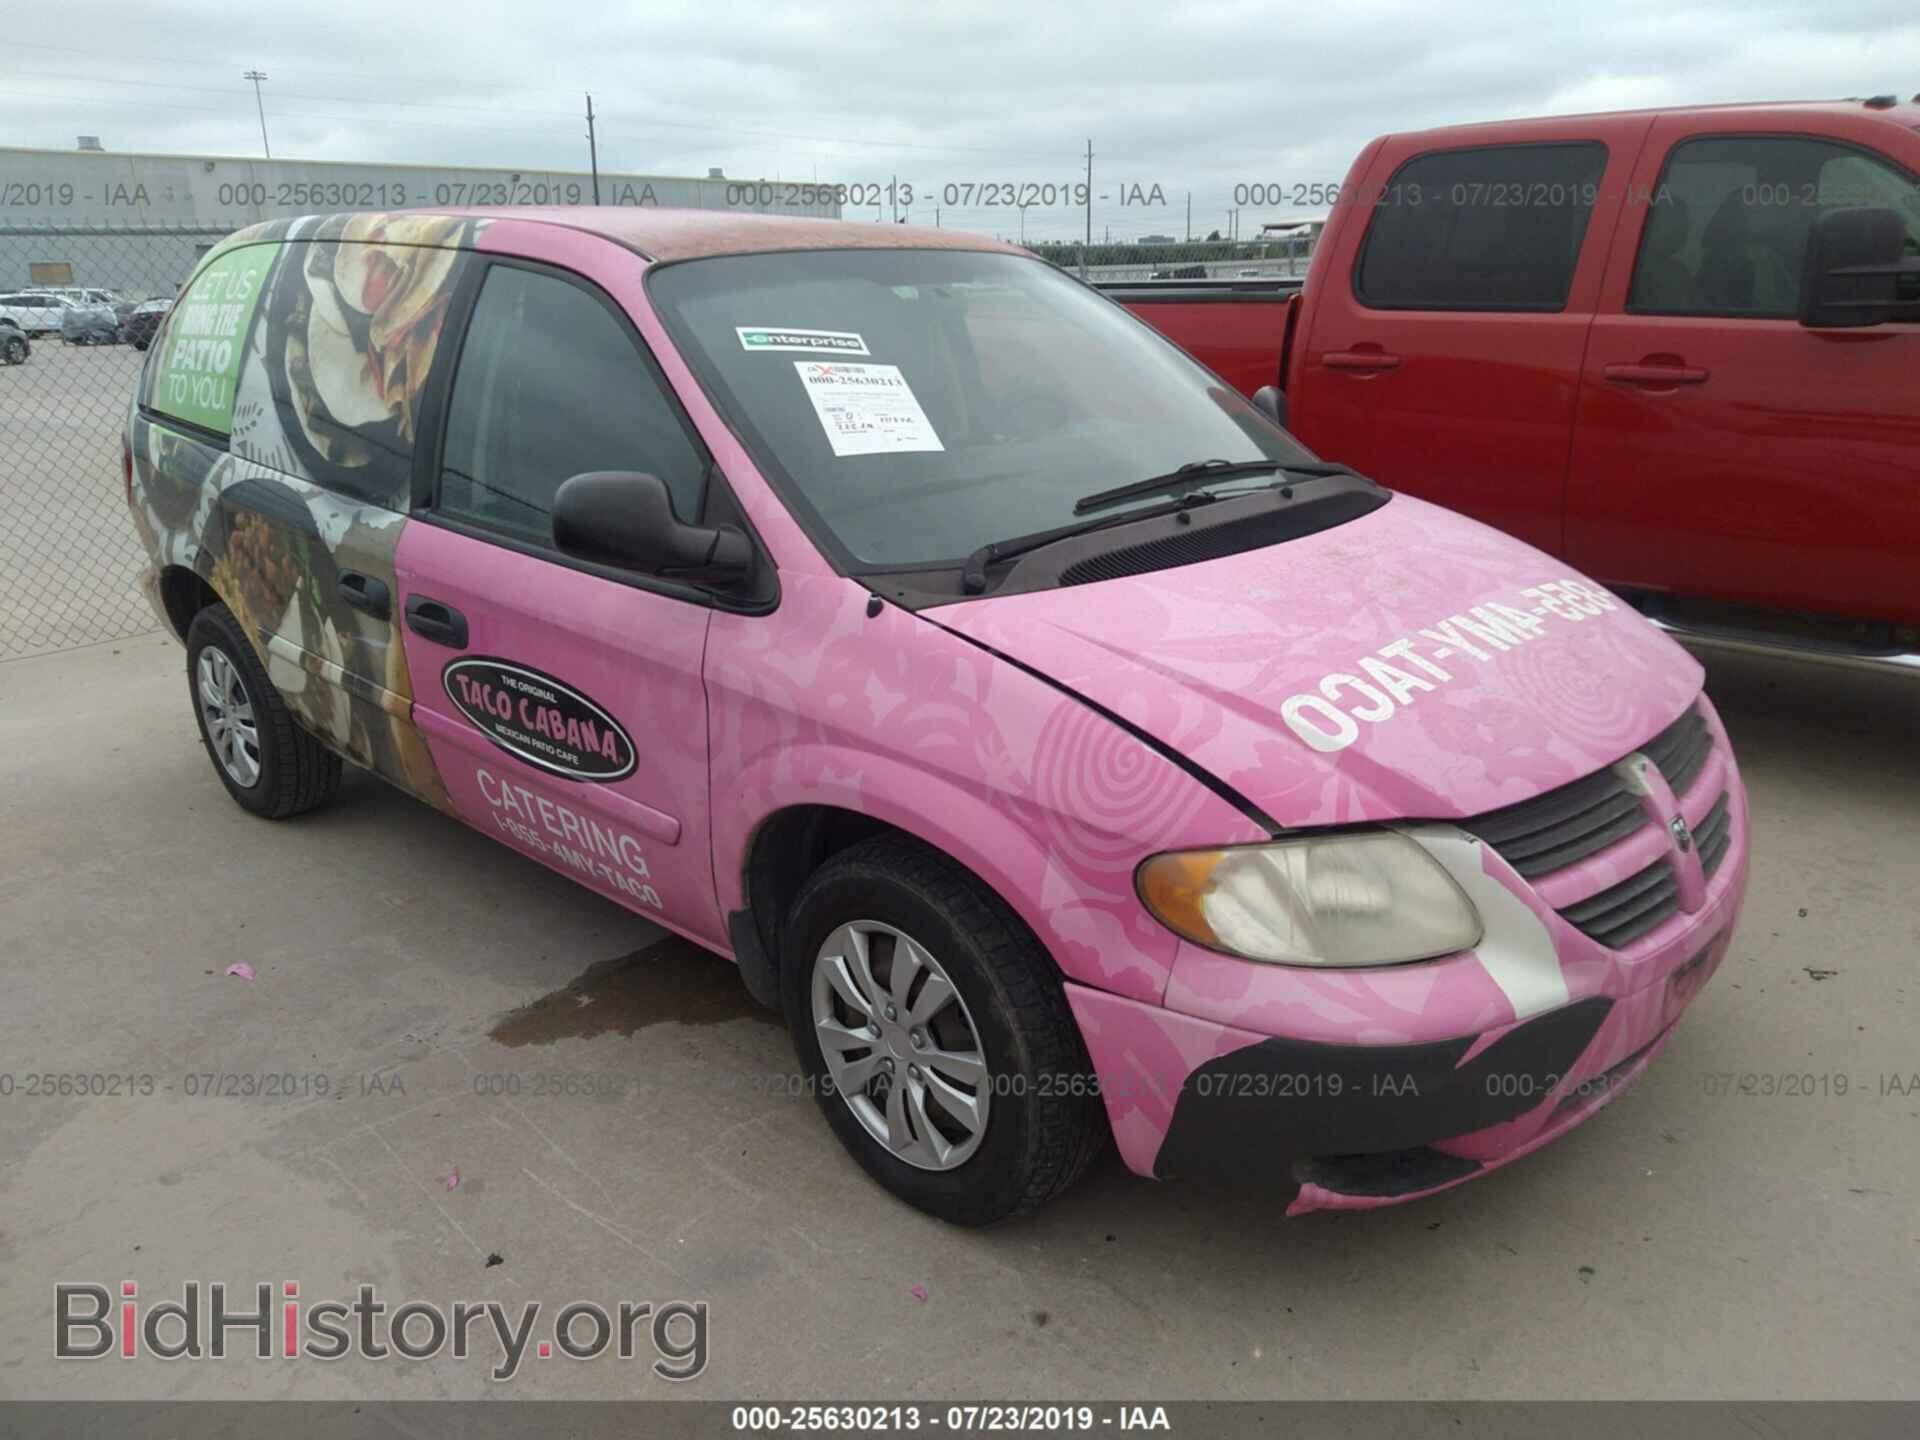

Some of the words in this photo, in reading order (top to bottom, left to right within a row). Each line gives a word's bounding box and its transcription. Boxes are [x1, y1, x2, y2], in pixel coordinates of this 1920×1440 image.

[191, 271, 229, 300] LET
[225, 269, 257, 300] US
[748, 332, 861, 348] enterprise
[171, 339, 232, 374] PATIO
[168, 374, 187, 404] TO
[501, 674, 518, 689] THE
[456, 674, 513, 721] TACO
[518, 697, 619, 765] CABANA
[476, 769, 650, 877] CATERING
